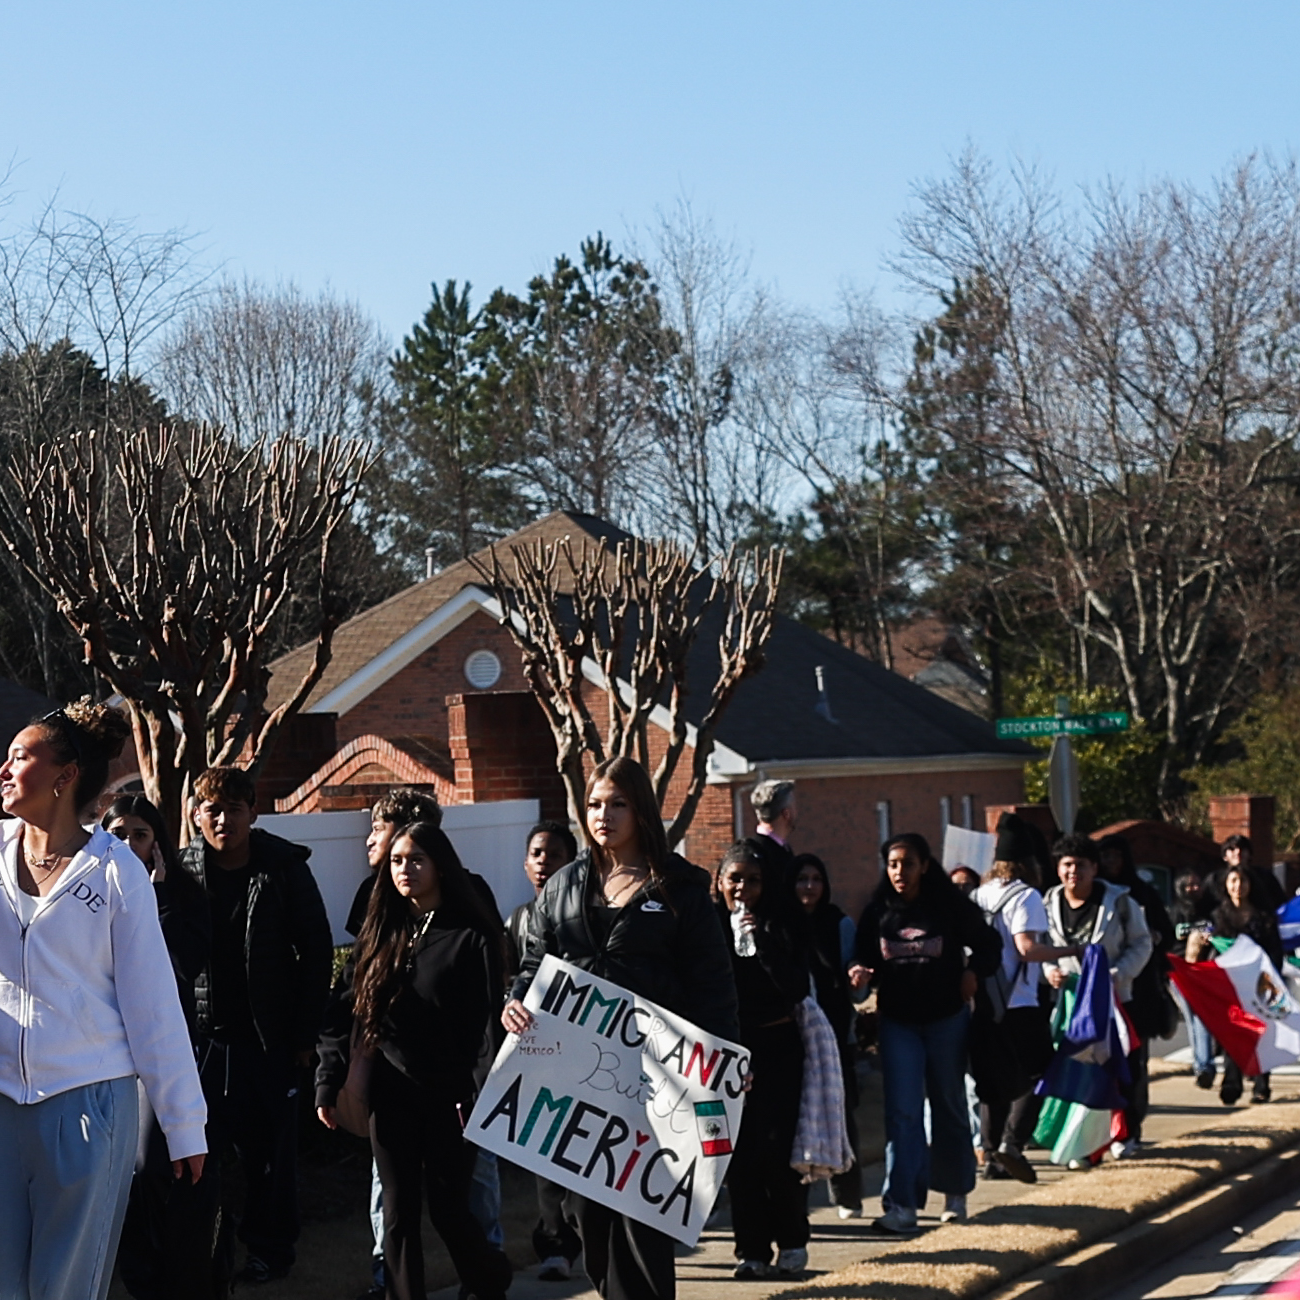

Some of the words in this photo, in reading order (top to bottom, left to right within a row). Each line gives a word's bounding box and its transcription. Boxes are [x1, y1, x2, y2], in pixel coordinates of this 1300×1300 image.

[1001, 720, 1060, 734] STOCKTON
[1064, 719, 1094, 730] WALK
[540, 970, 749, 1099] IMMIGRANTS
[579, 1042, 689, 1133] Built
